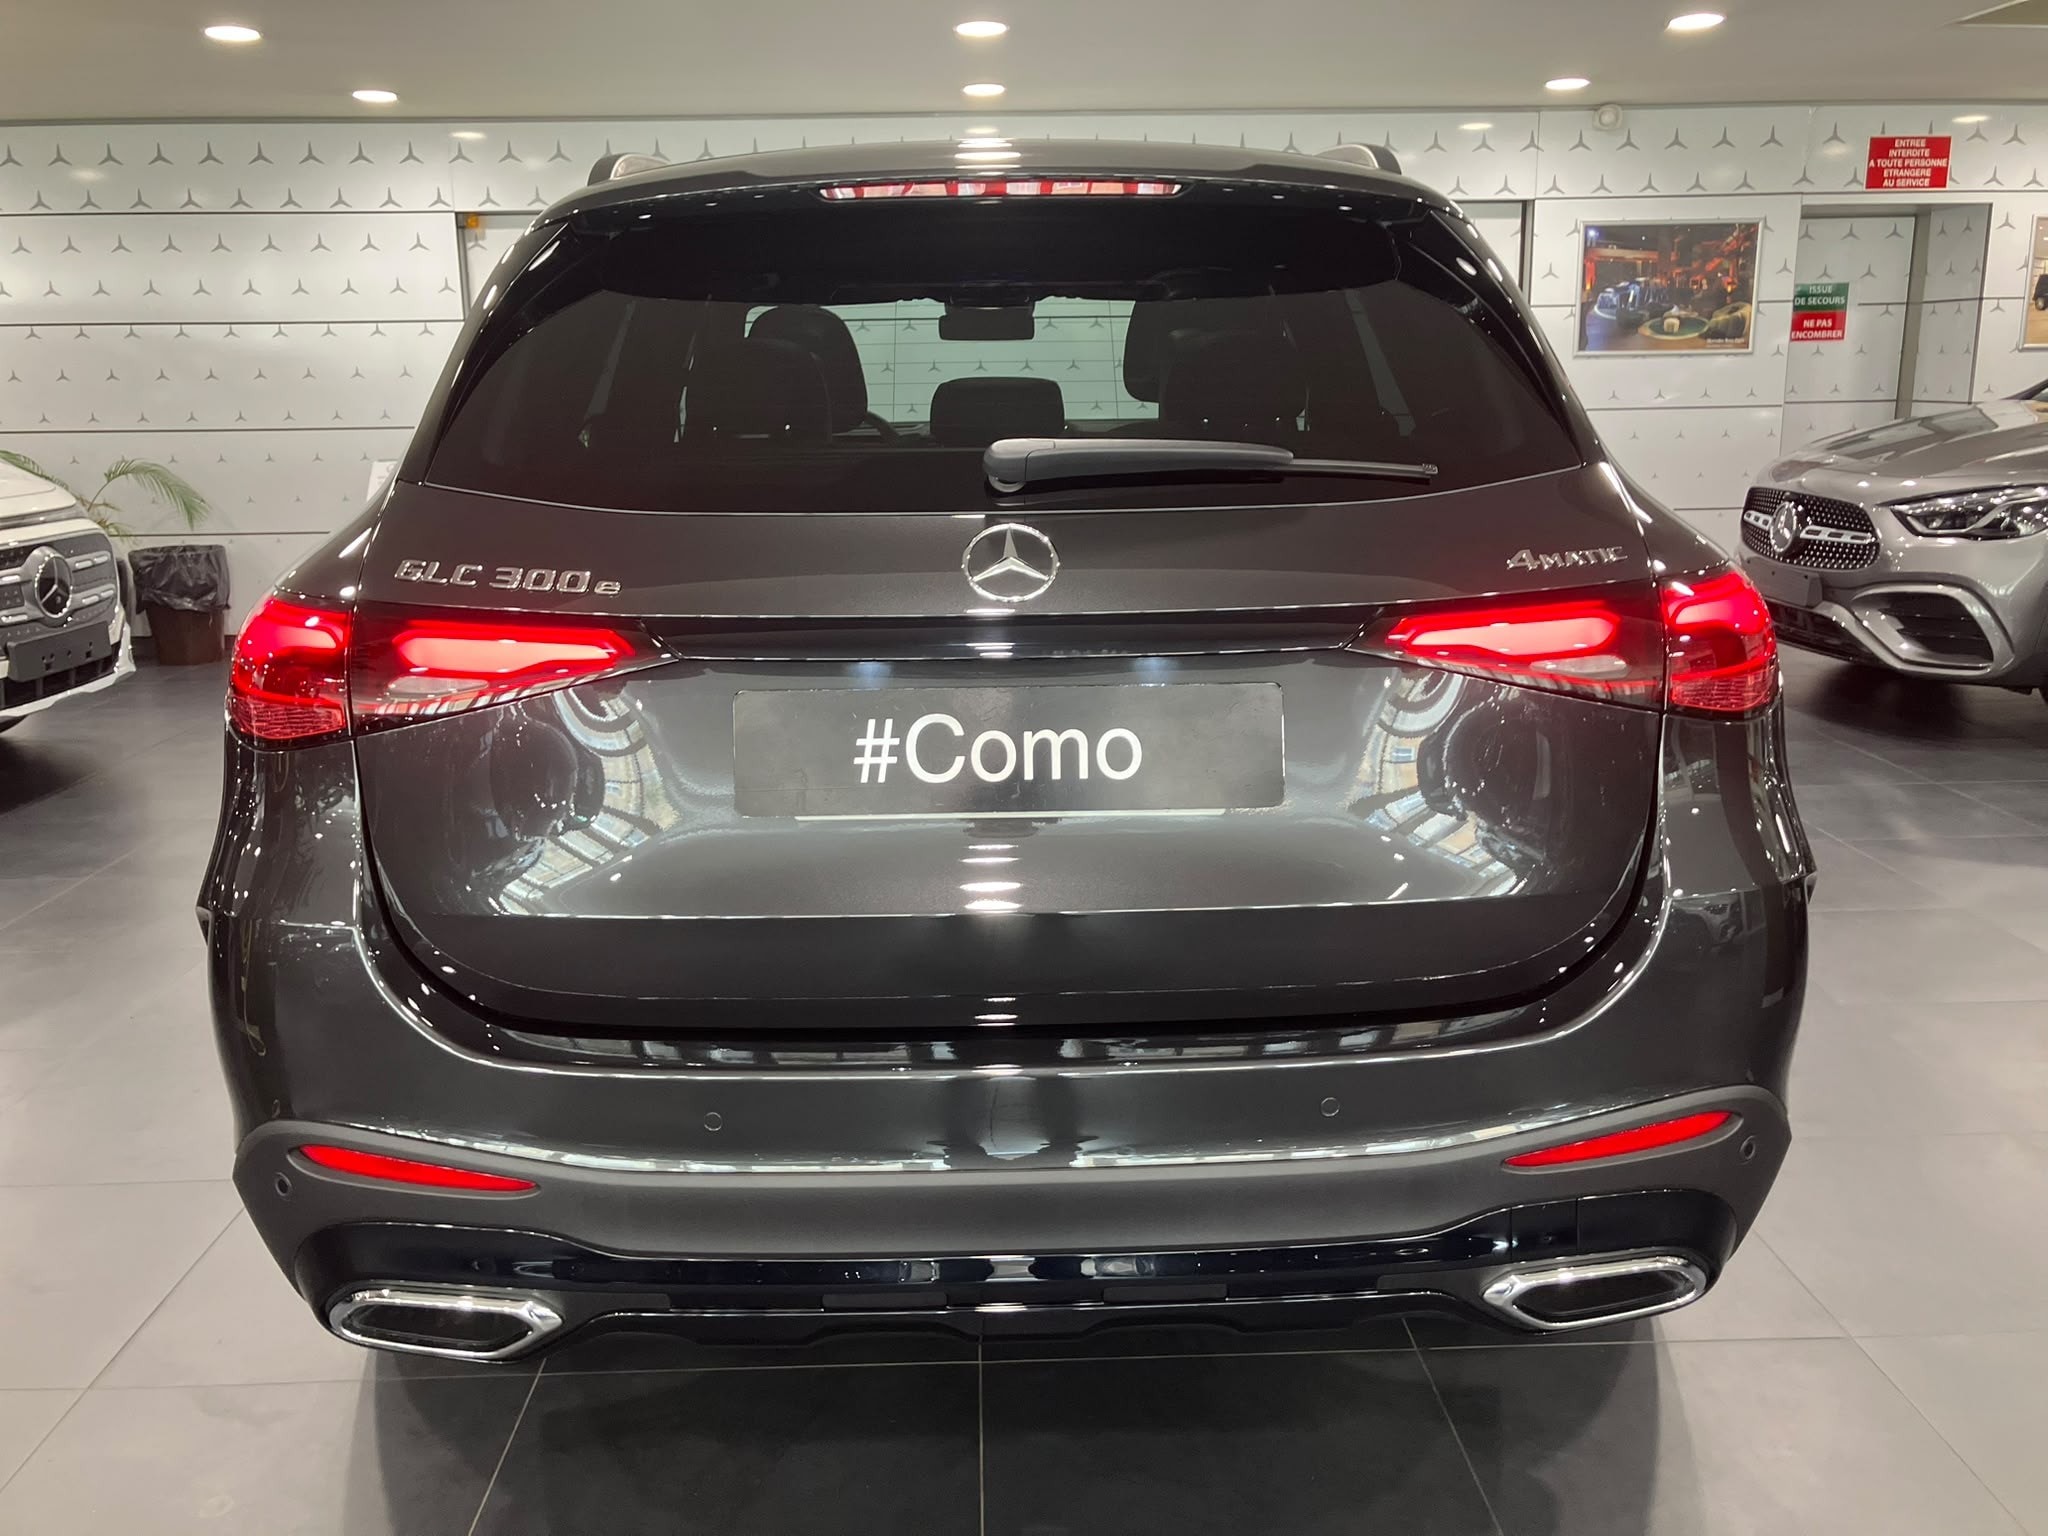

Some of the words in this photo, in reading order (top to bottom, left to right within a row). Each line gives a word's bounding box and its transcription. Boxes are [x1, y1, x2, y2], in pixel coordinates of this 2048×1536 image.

[1894, 138, 1927, 148] ENTREE
[1888, 148, 1931, 158] INTERDITE
[1868, 159, 1875, 168] A
[1876, 159, 1903, 168] TOUTE
[1904, 158, 1948, 168] PERSONNE
[1883, 168, 1932, 178] ETRANGERE
[1882, 178, 1895, 187] AU
[1895, 178, 1931, 187] SERVICE
[1809, 285, 1833, 294] ISSUE
[1794, 297, 1807, 306] DE
[1807, 296, 1846, 306] SECOURS
[1803, 319, 1815, 329] NE
[1816, 318, 1833, 328] PAS
[1791, 330, 1843, 339] ENCOMBRER
[1506, 545, 1629, 571] 4MATIC
[394, 558, 484, 587] GLC
[853, 713, 1143, 784] #Como
